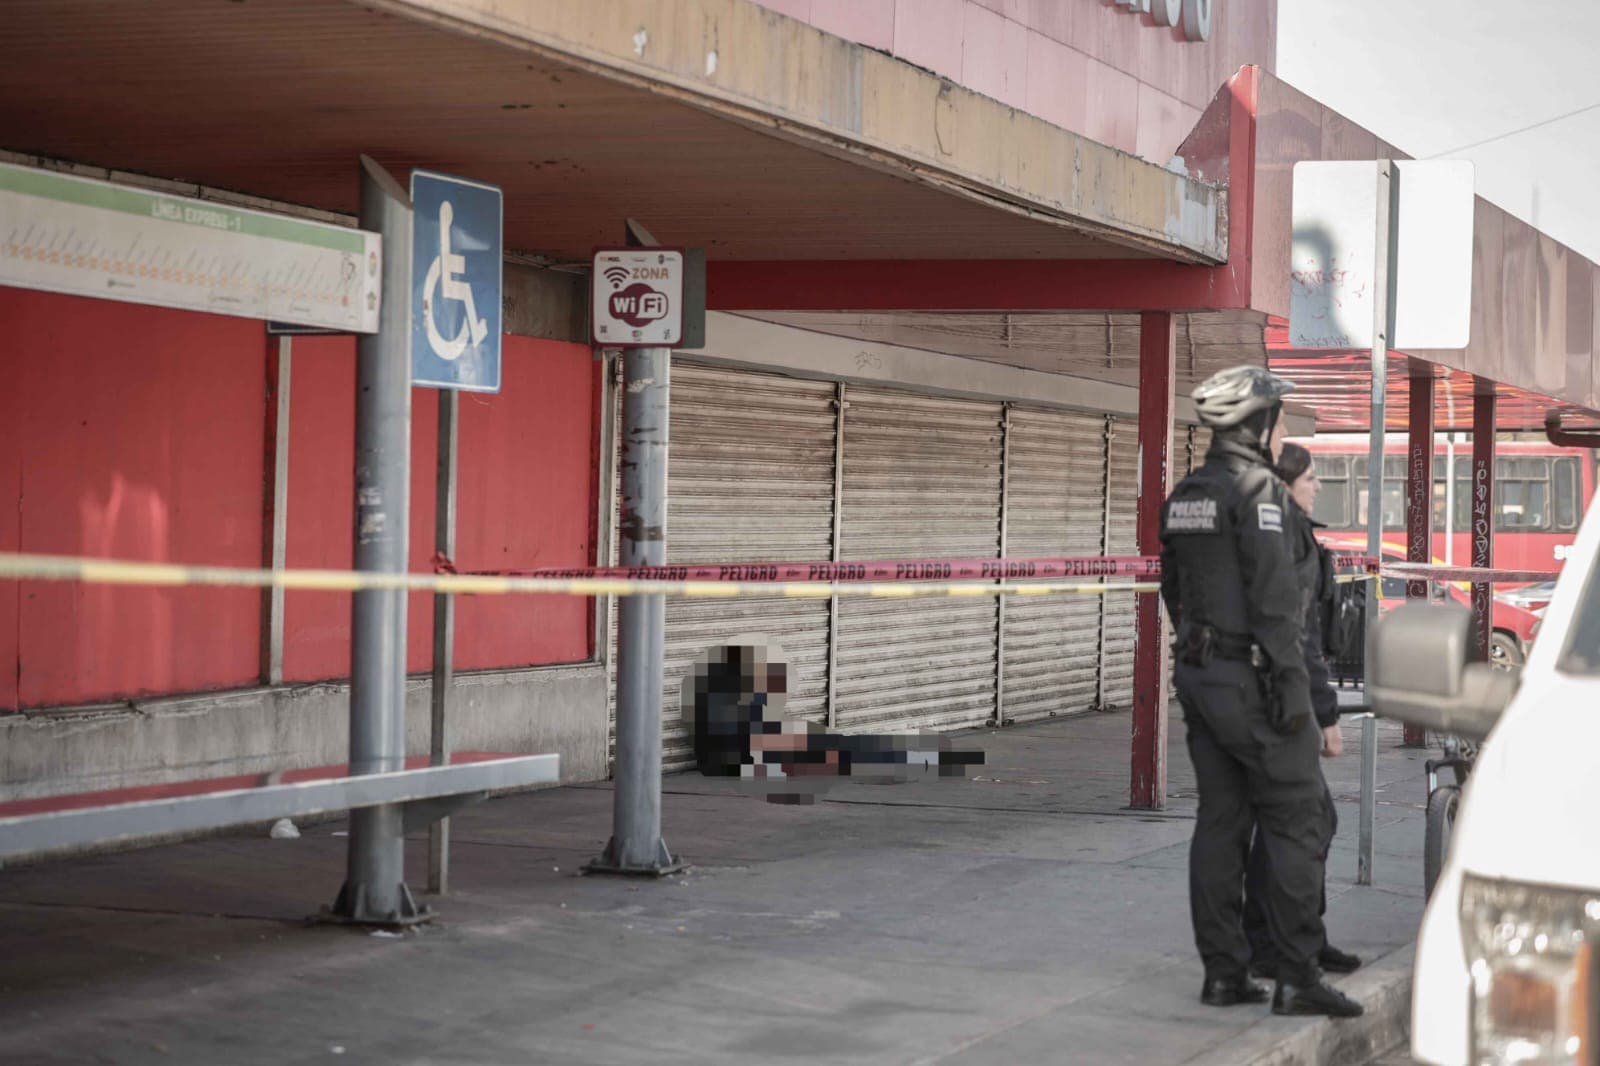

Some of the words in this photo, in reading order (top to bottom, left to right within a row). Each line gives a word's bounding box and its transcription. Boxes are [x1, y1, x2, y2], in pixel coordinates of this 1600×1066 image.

[632, 267, 669, 279] ZONA
[627, 566, 687, 581] PELIGRO
[719, 565, 778, 581] PELIGRO
[808, 564, 866, 580] PELIGRO
[896, 562, 951, 579] PELIGRO
[982, 561, 1036, 578] PELIGRO
[1064, 559, 1118, 576] PELIGRO
